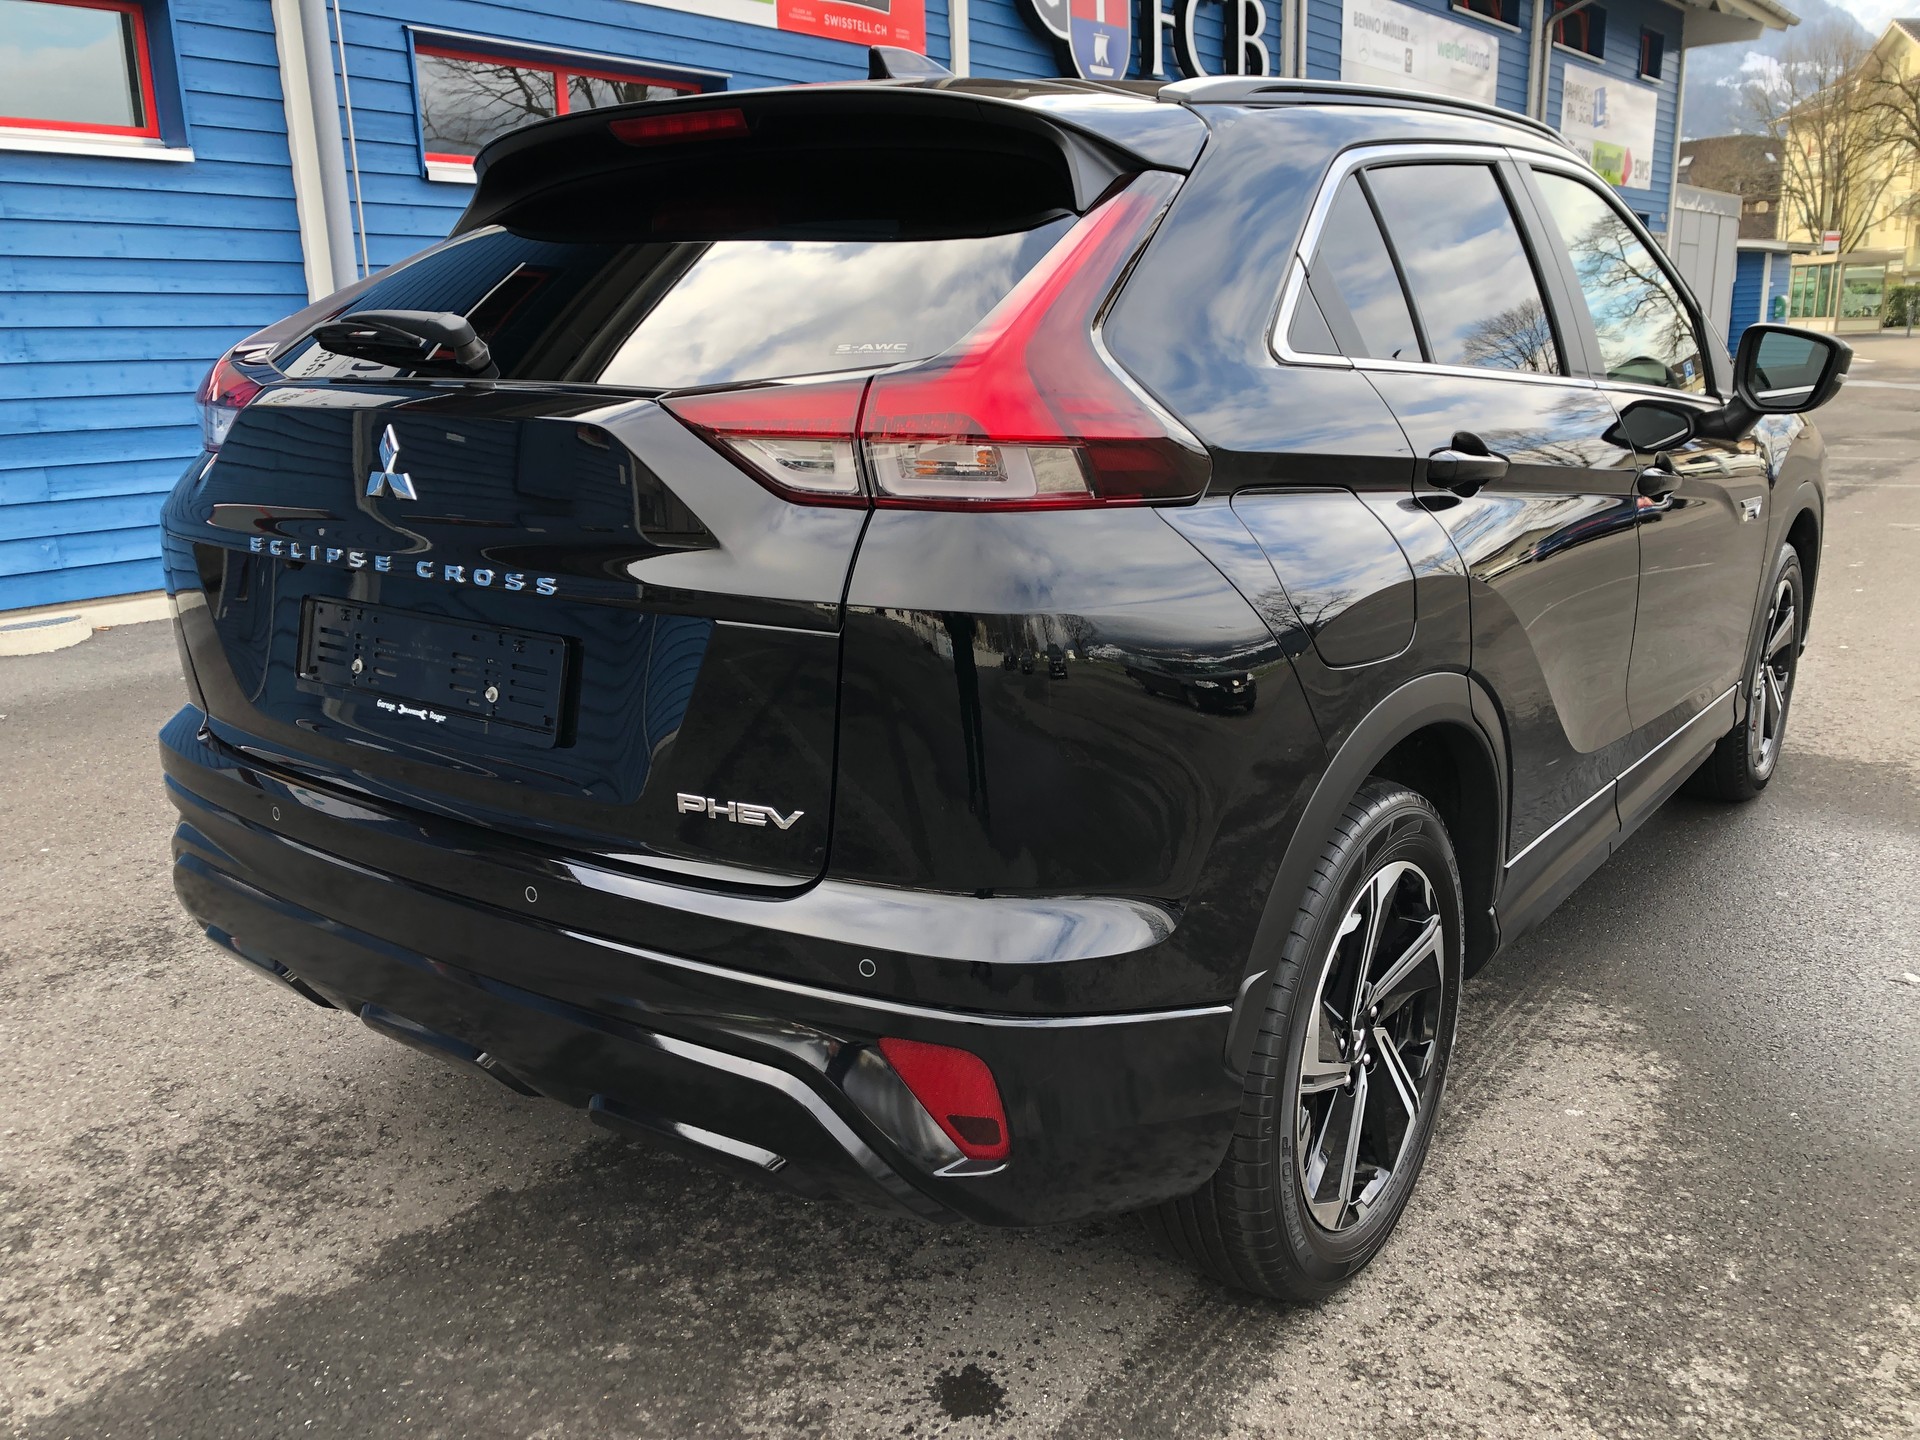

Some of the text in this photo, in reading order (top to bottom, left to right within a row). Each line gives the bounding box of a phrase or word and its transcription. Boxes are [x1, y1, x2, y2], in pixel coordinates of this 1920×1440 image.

[824, 13, 888, 36] SWISSTELL.CH
[1353, 11, 1381, 34] BENNO
[836, 343, 908, 351] S-AWC
[250, 536, 558, 596] ECLIPSE CROSS
[676, 792, 805, 830] PHEV
